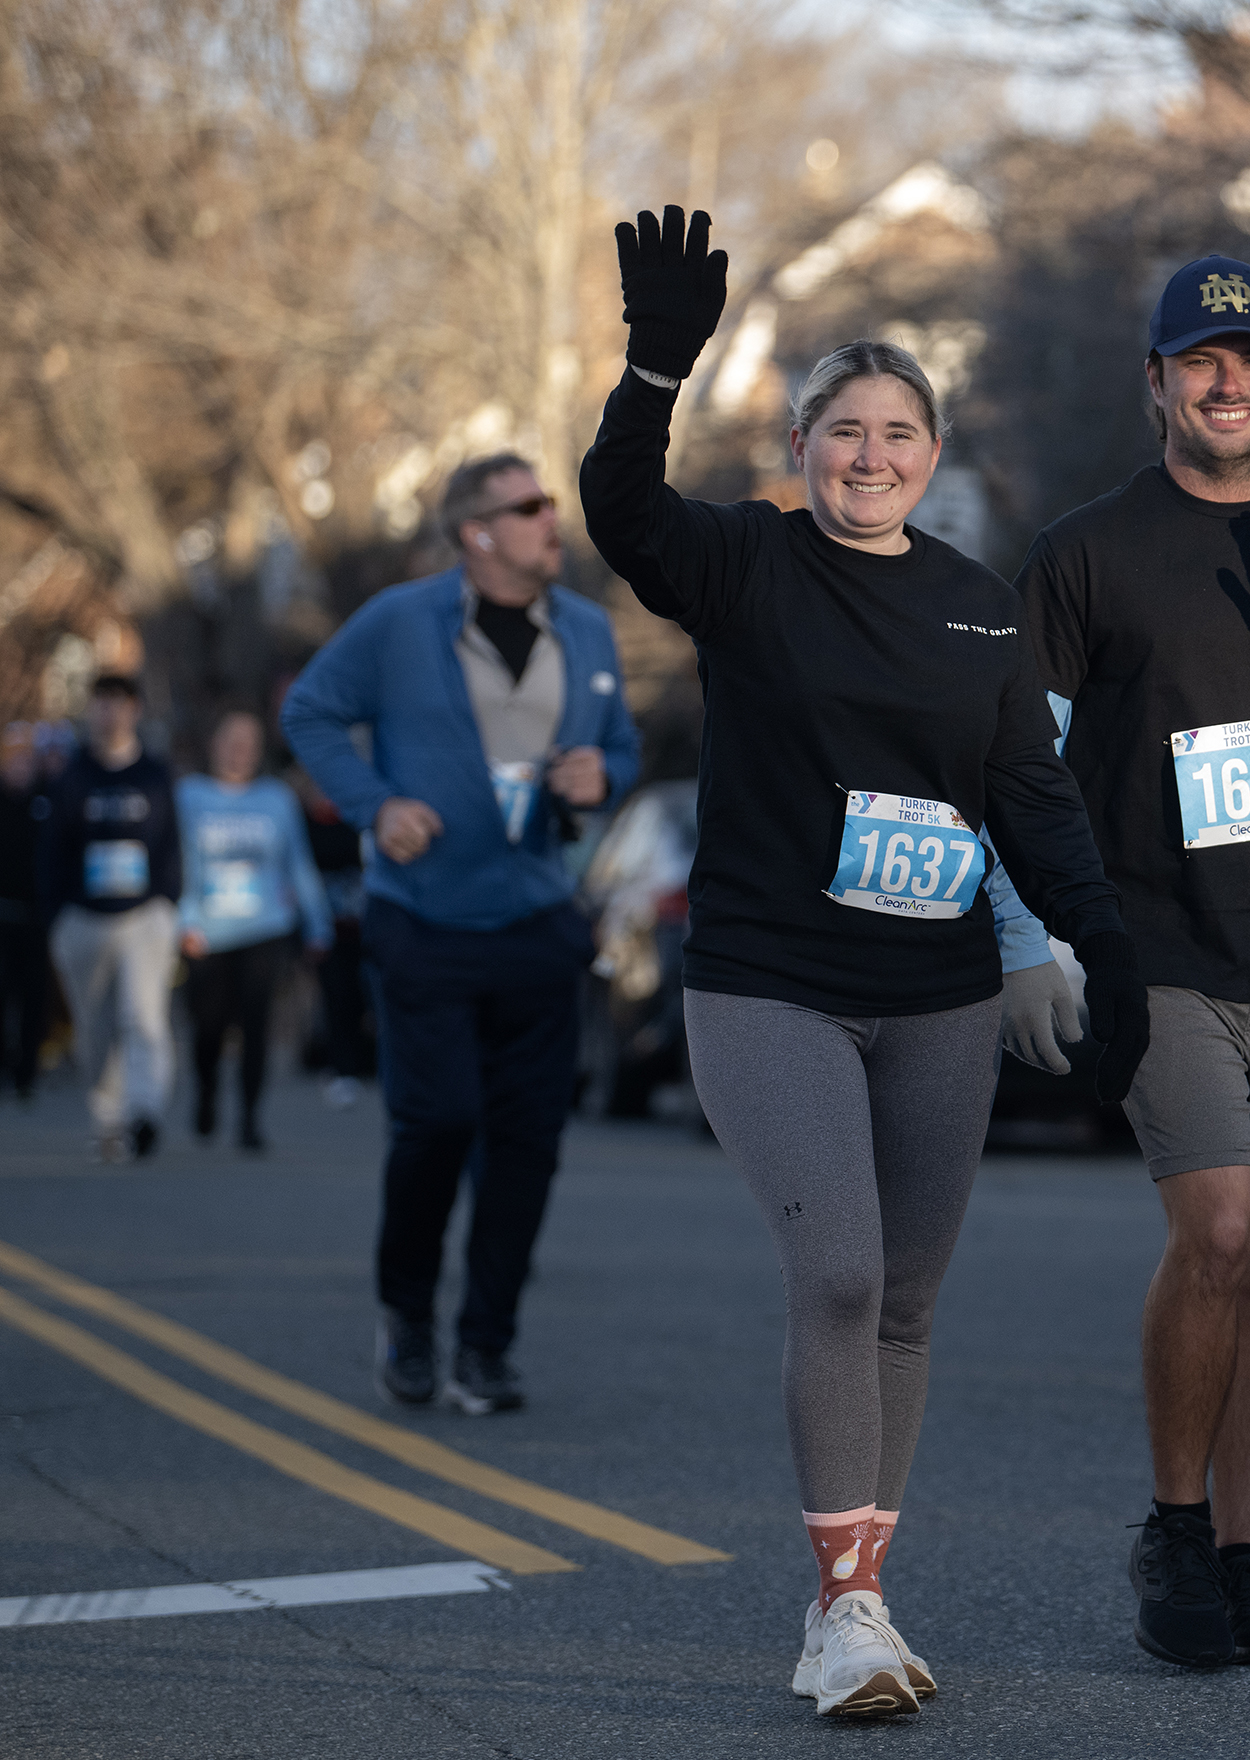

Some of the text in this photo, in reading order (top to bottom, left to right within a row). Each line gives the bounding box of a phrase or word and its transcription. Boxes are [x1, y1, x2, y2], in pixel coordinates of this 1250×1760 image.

[946, 622, 969, 631] PASS
[970, 625, 988, 635] THE
[1223, 734, 1250, 747] TROT
[899, 797, 939, 812] TURKEY
[898, 810, 941, 825] TROT 5K
[857, 830, 975, 899] 1637
